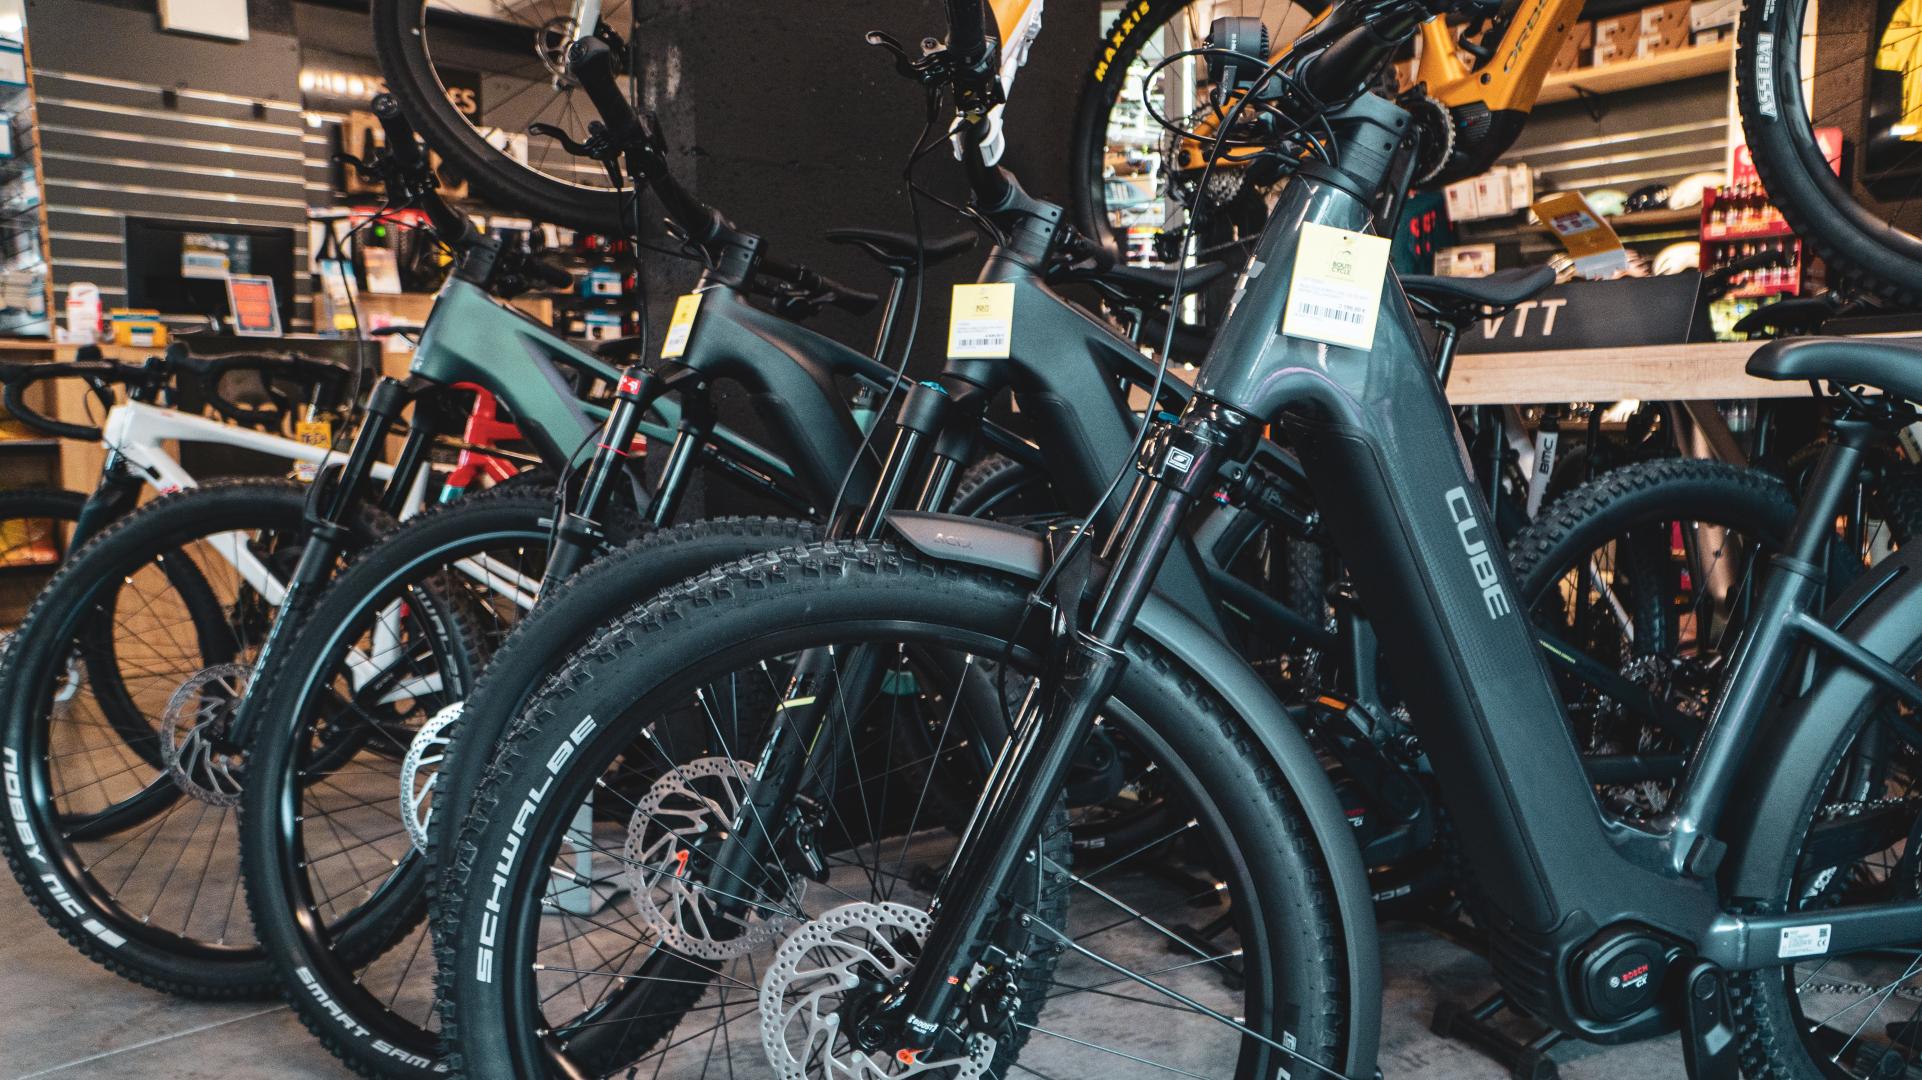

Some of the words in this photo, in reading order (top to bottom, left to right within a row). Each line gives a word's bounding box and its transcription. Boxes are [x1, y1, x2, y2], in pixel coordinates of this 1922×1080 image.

[1095, 1, 1150, 82] MAXXIS
[1756, 32, 1778, 121] ASSEGAI
[1483, 298, 1567, 339] VTT
[1539, 437, 1553, 475] BMC
[1445, 486, 1511, 620] CUBE
[3, 747, 47, 864] NOBBY
[40, 873, 87, 918] NIC
[476, 714, 597, 984] SCHWALBE
[295, 966, 371, 1037] SMART
[370, 1039, 431, 1069] SAM
[1622, 964, 1649, 982] BOSCH
